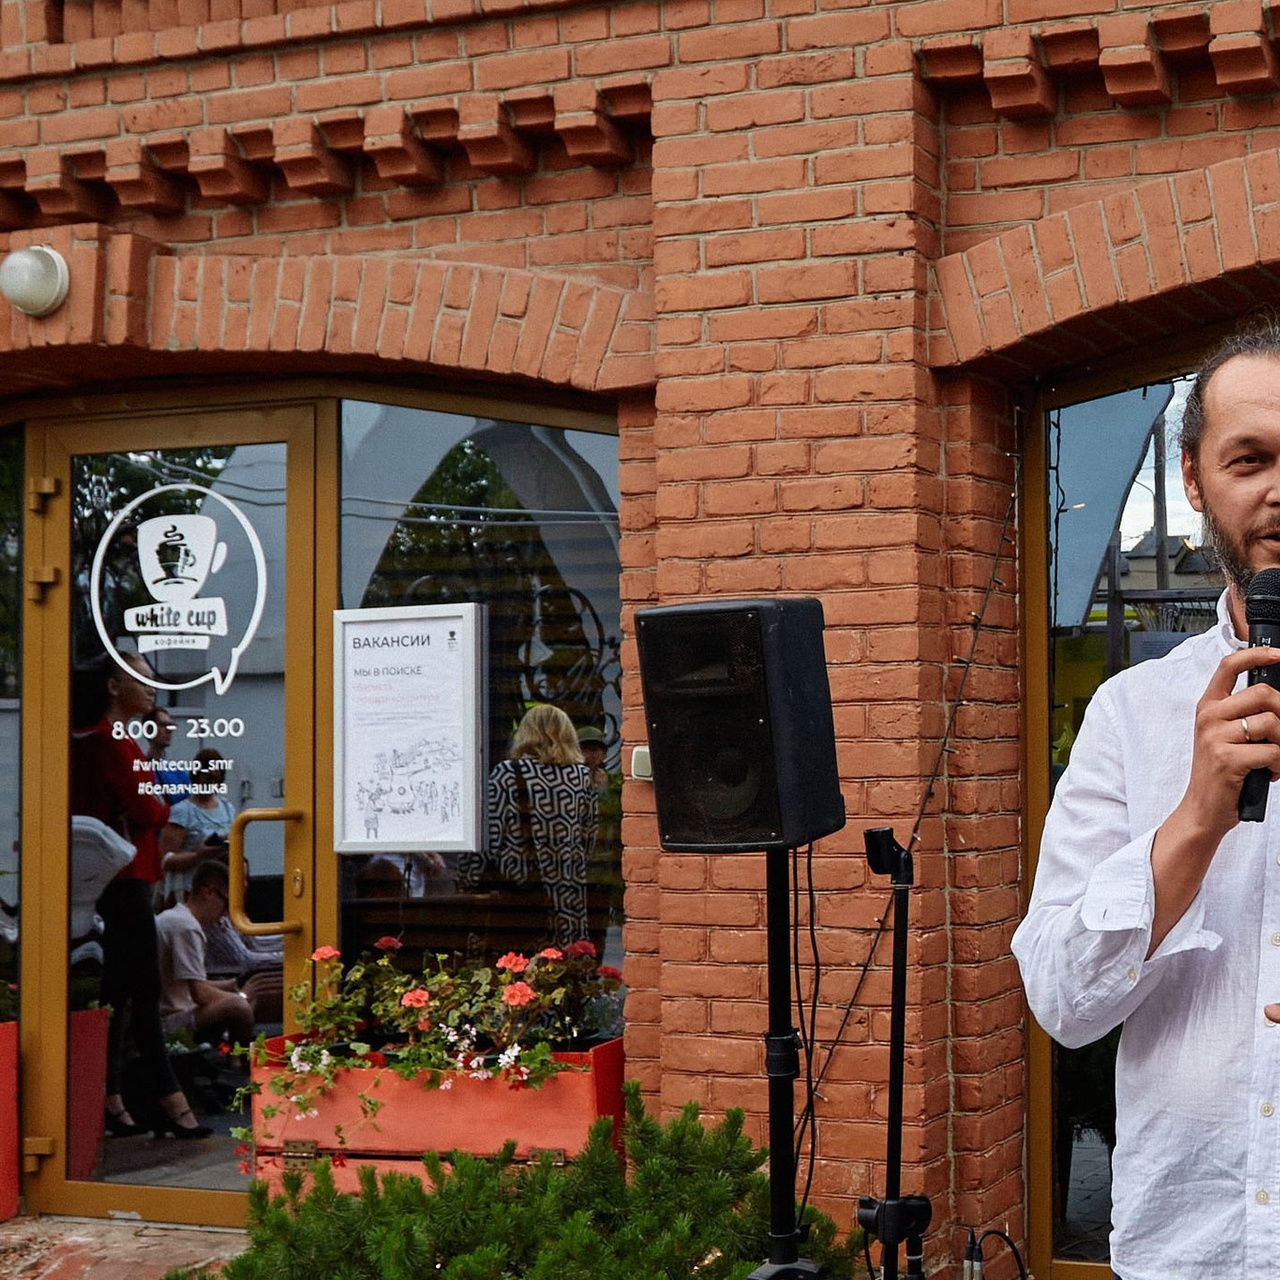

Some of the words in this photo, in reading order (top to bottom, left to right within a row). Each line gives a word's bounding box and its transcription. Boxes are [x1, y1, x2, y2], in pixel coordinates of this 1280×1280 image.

[135, 606, 180, 627] white
[187, 608, 216, 629] cup
[352, 634, 431, 649] ВАКАНСИИ
[353, 668, 371, 677] МЫ
[373, 667, 380, 676] В
[382, 665, 423, 676] ПОИСКЕ
[111, 720, 158, 740] 8.00
[186, 717, 245, 738] 23.00
[132, 758, 234, 775] #whitecup_smr
[138, 781, 228, 795] #белаячашка
